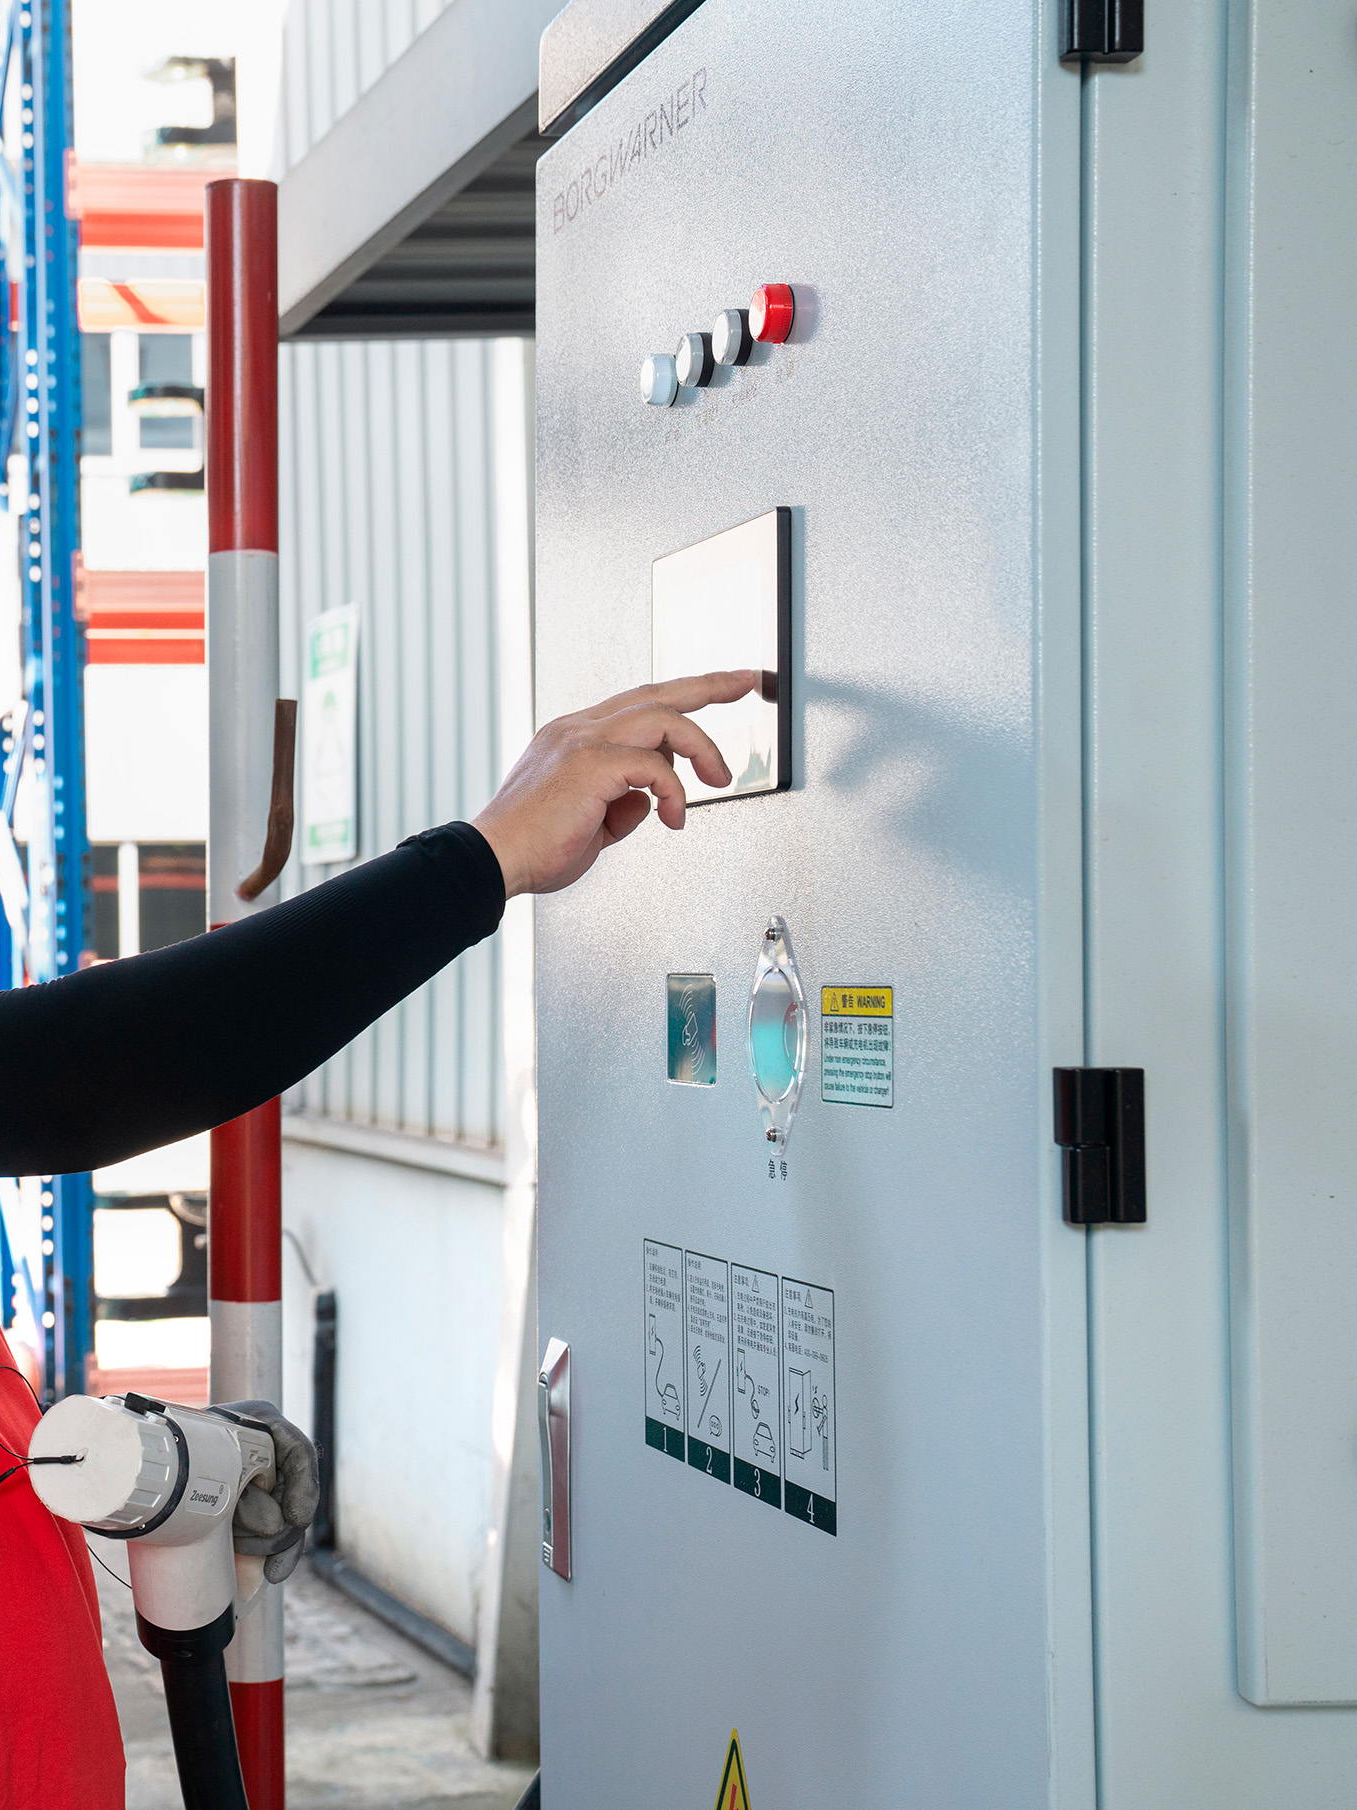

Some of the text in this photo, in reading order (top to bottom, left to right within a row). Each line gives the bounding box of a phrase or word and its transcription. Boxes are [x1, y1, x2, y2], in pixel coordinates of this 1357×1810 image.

[552, 66, 708, 235] BORGWARNER
[841, 994, 886, 1009] 警告 WARNING
[662, 1427, 668, 1453] 1
[706, 1446, 713, 1474] 2
[753, 1468, 761, 1498] 3
[189, 1490, 219, 1507] Zeesung
[806, 1493, 815, 1524] 4
